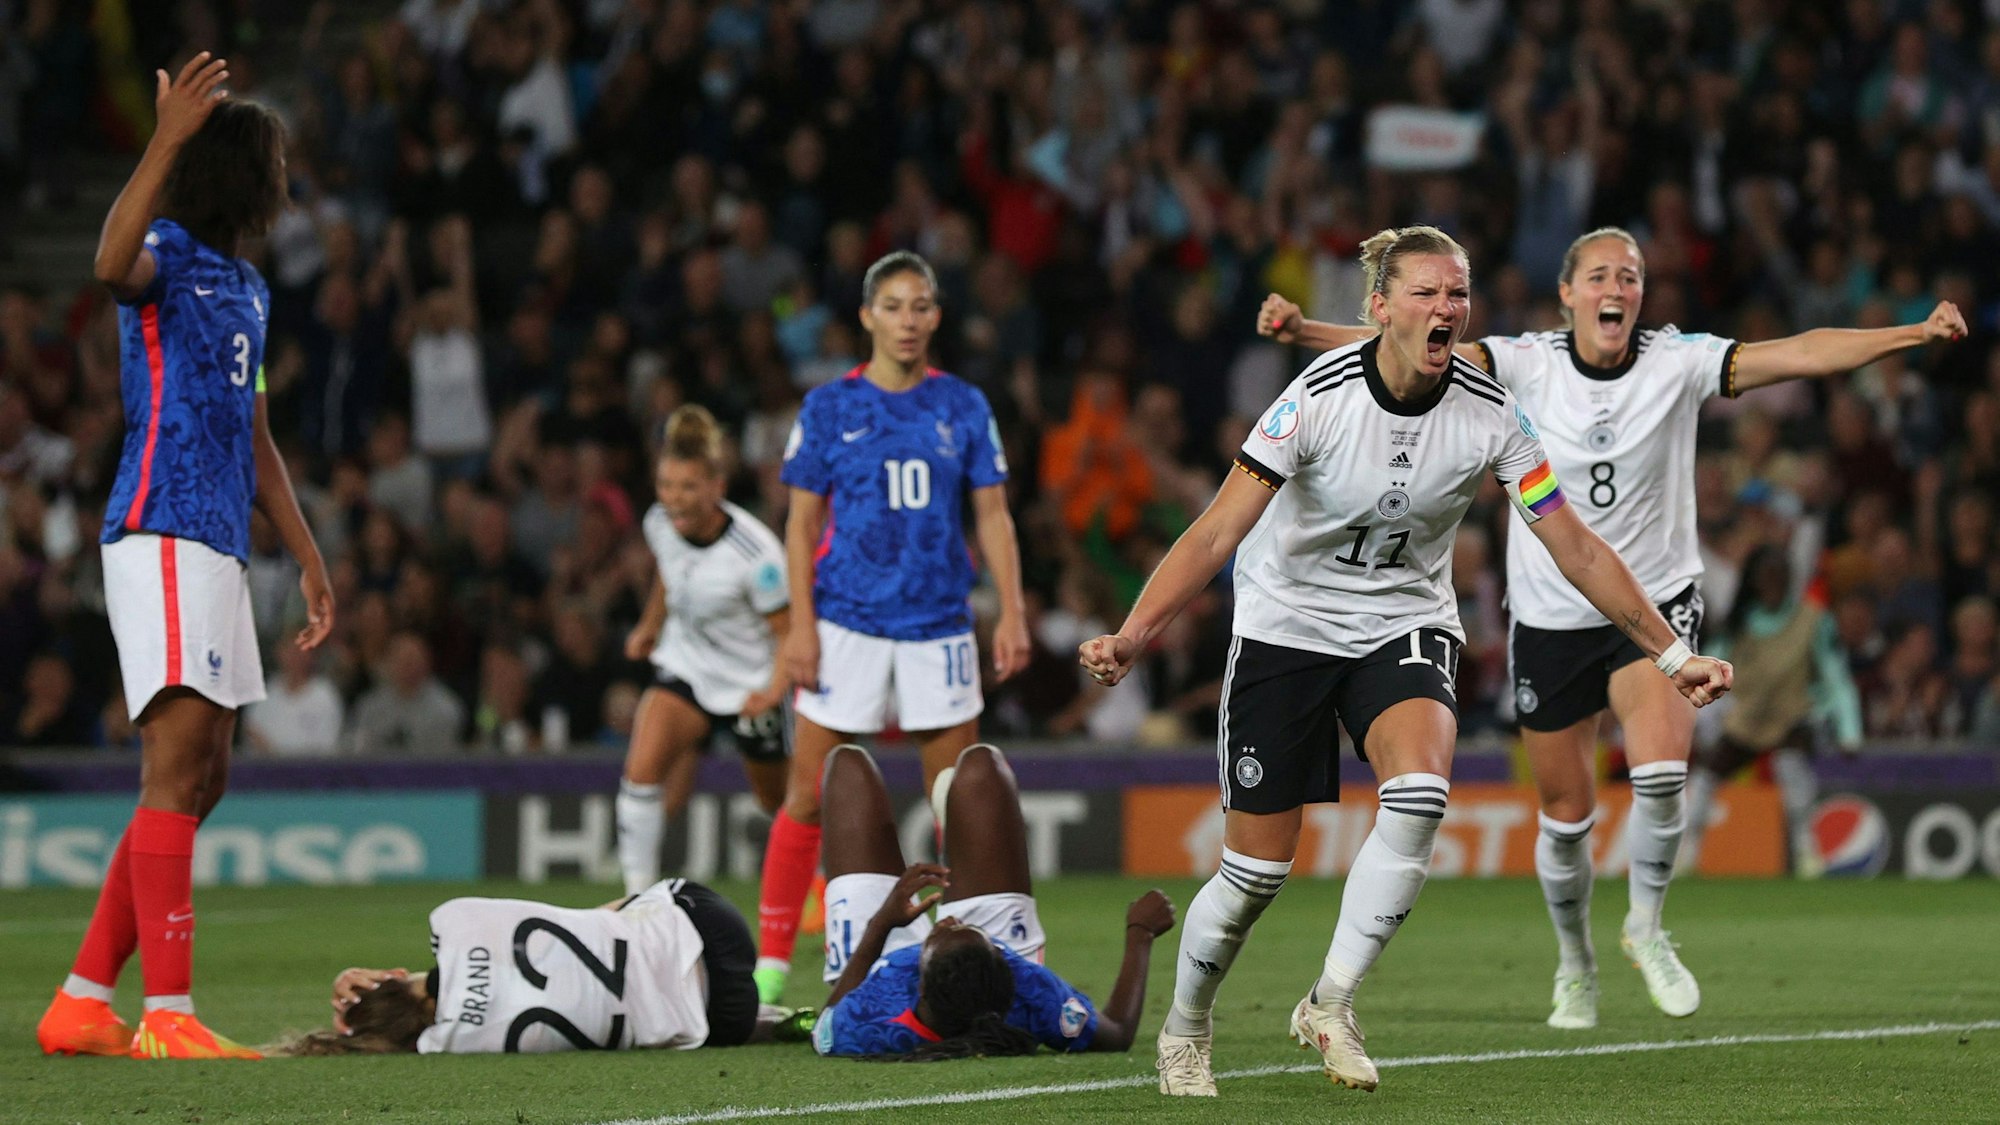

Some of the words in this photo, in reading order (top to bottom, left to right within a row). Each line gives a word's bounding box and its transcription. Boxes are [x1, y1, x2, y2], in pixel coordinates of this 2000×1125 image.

[230, 333, 250, 387] 3
[884, 459, 931, 510] 10
[1388, 460, 1413, 469] adidas
[1590, 461, 1616, 508] 8
[1334, 525, 1412, 570] 11
[942, 642, 972, 688] 10
[1398, 629, 1454, 688] 11
[0, 804, 427, 888] isnse
[459, 946, 491, 1027] BRAND
[504, 917, 628, 1053] 22
